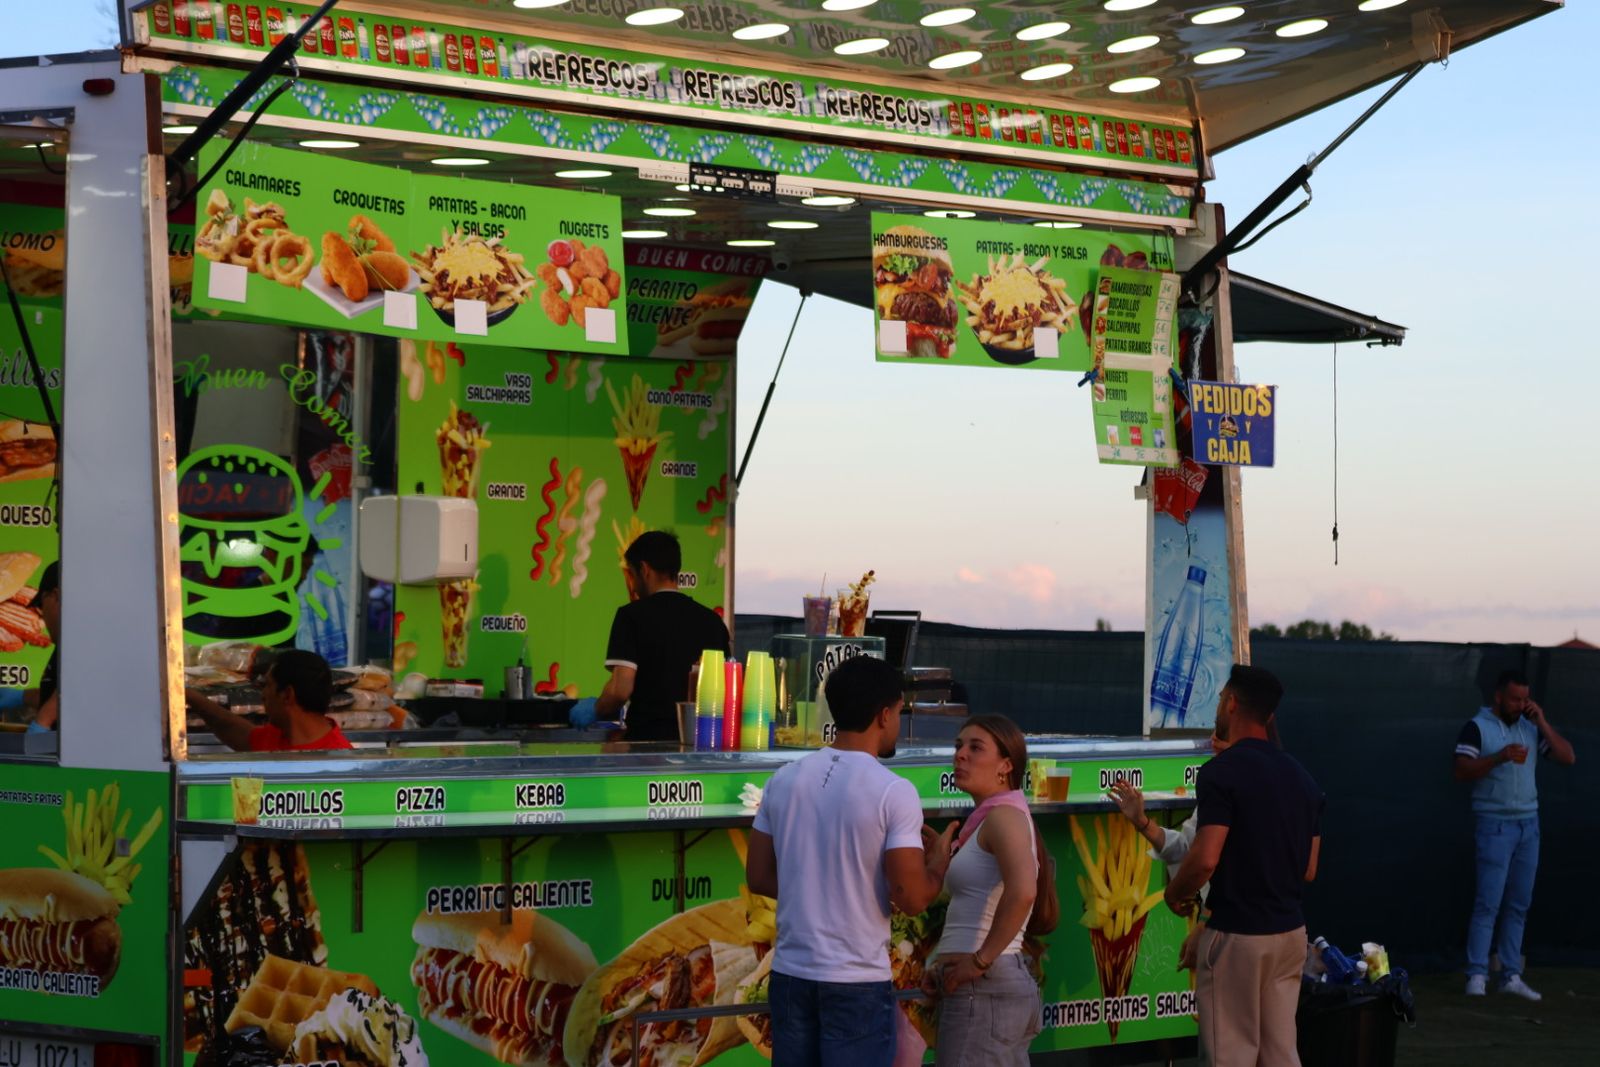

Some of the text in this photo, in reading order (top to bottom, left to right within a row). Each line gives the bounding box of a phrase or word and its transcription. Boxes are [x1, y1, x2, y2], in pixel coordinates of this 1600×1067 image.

[528, 50, 931, 126] REFRESCOS REFRESCOS REFRESCOS
[225, 169, 301, 197] CALAMARES
[333, 188, 406, 215] CROQUETAS
[428, 195, 478, 215] PATATAS
[490, 203, 526, 220] BACON
[452, 220, 505, 239] Y SALSAS
[559, 220, 609, 239] NUGGETS
[1, 232, 56, 251] LOMO
[873, 232, 948, 252] HAMBURGUESAS
[976, 240, 1015, 256] PATATAS
[1023, 242, 1050, 257] BACON
[1052, 245, 1059, 258] Y
[1061, 245, 1088, 261] SALSA
[637, 248, 766, 275] BUEN COMER
[627, 278, 698, 301] PERRITO
[627, 304, 694, 325] ALIENTE
[1105, 338, 1152, 354] PATATAS GRANDES
[505, 375, 531, 389] VASO
[1105, 370, 1128, 384] NUGGETS
[467, 387, 531, 403] SALCHIPAPAS
[648, 391, 712, 407] CONO PATATAS
[1106, 388, 1127, 402] PERRITO
[1191, 383, 1272, 417] PEDIDOS
[1207, 438, 1251, 464] CAJA
[662, 463, 696, 477] GRANDE
[488, 484, 525, 499] GRANDE
[1, 506, 51, 525] QUESO
[482, 613, 526, 631] PEQUEÑO
[259, 790, 343, 816] CADILLOS
[396, 788, 445, 811] PIZZA
[516, 783, 565, 807] KEBAB
[648, 781, 703, 804] DURUM
[427, 880, 592, 913] PERRITO CALIENTE
[652, 876, 711, 902] DUUM
[43, 973, 99, 997] CALIENTE
[1042, 1000, 1100, 1026] PATATAS
[1104, 995, 1148, 1021] FRITAS
